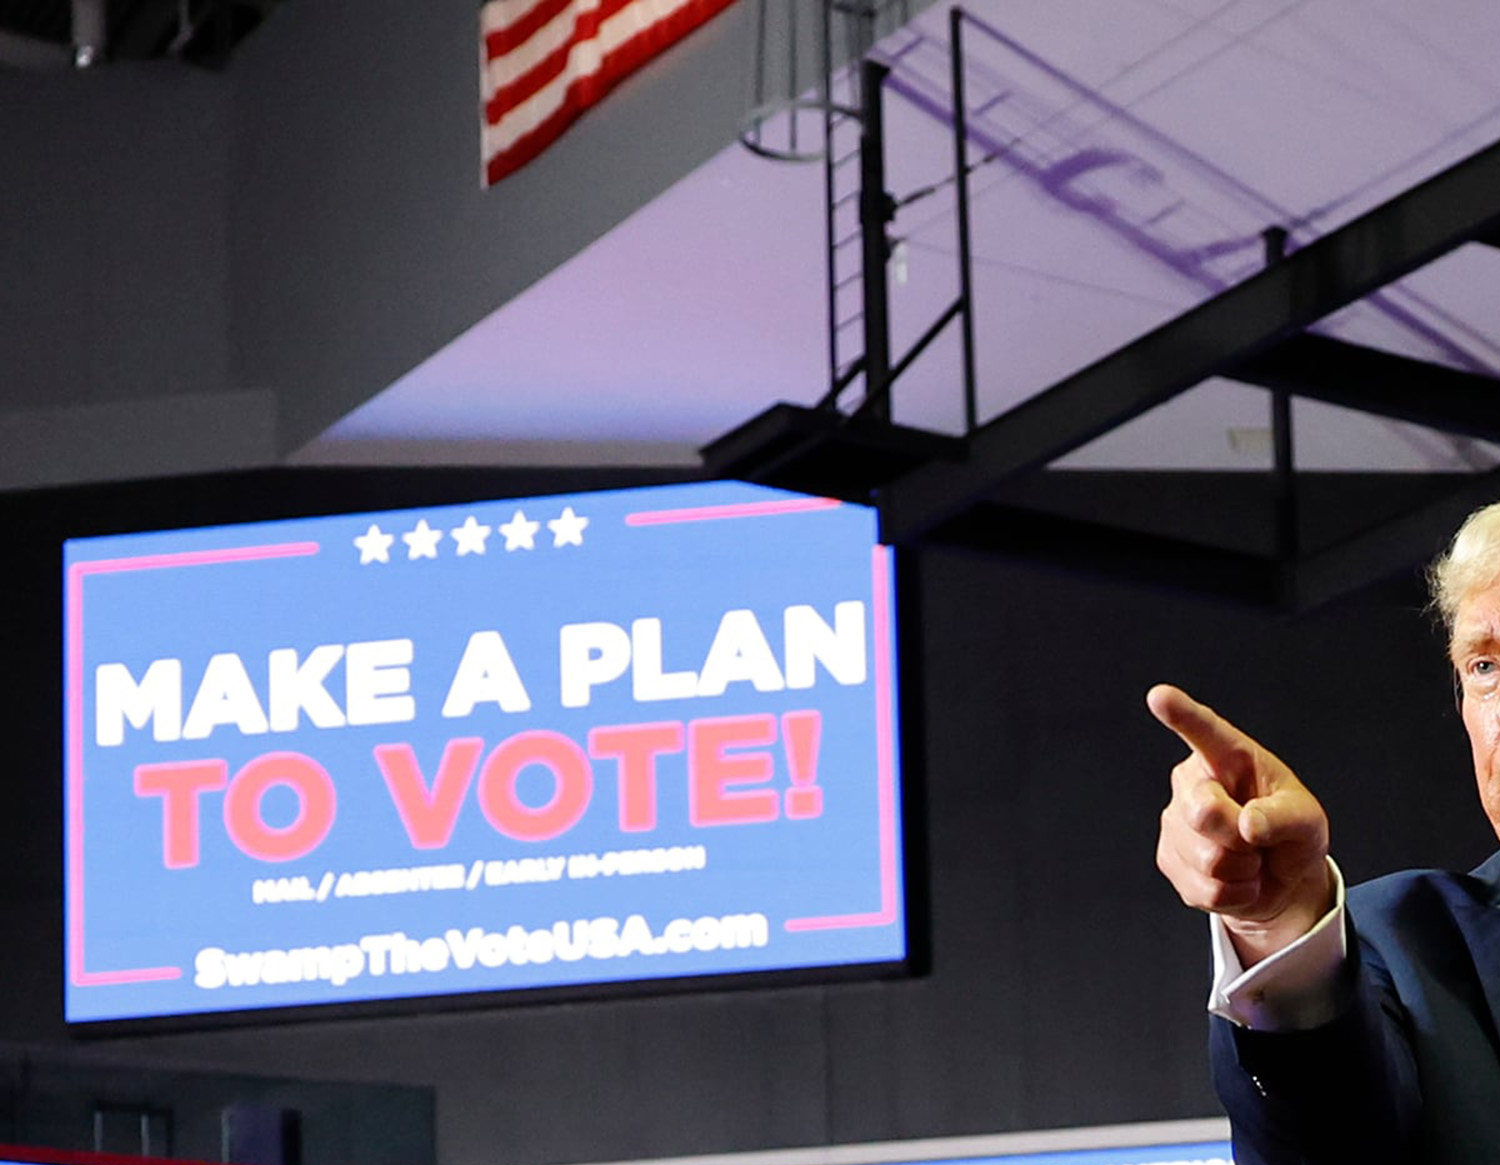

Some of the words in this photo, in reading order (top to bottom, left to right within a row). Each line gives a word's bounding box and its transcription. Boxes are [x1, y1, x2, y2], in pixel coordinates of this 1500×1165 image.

[95, 638, 415, 747] MAKE
[441, 631, 532, 717] A
[559, 600, 868, 708] PLAN
[133, 751, 338, 870] TO
[373, 710, 824, 850] VOTE!
[252, 876, 316, 904] MAIL
[194, 913, 769, 989] SwampTheVoteUSA.com
